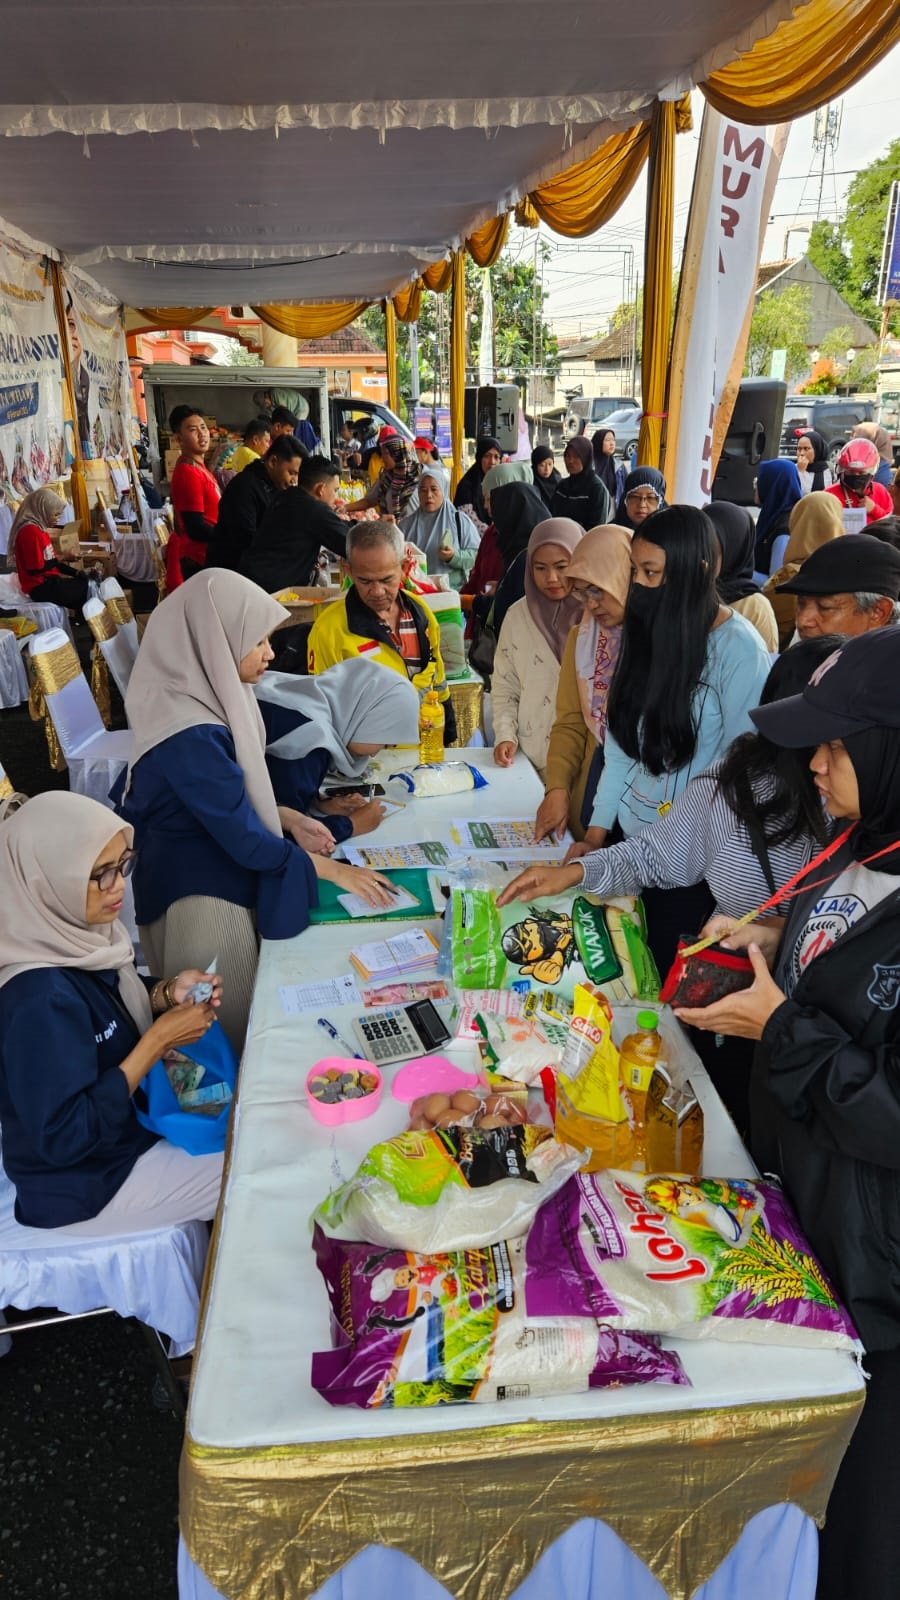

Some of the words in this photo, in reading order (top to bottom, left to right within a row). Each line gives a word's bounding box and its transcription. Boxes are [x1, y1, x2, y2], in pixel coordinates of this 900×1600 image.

[578, 906, 607, 970] WAROK
[572, 1017, 602, 1042] SunCo
[613, 1179, 707, 1282] Lahar
